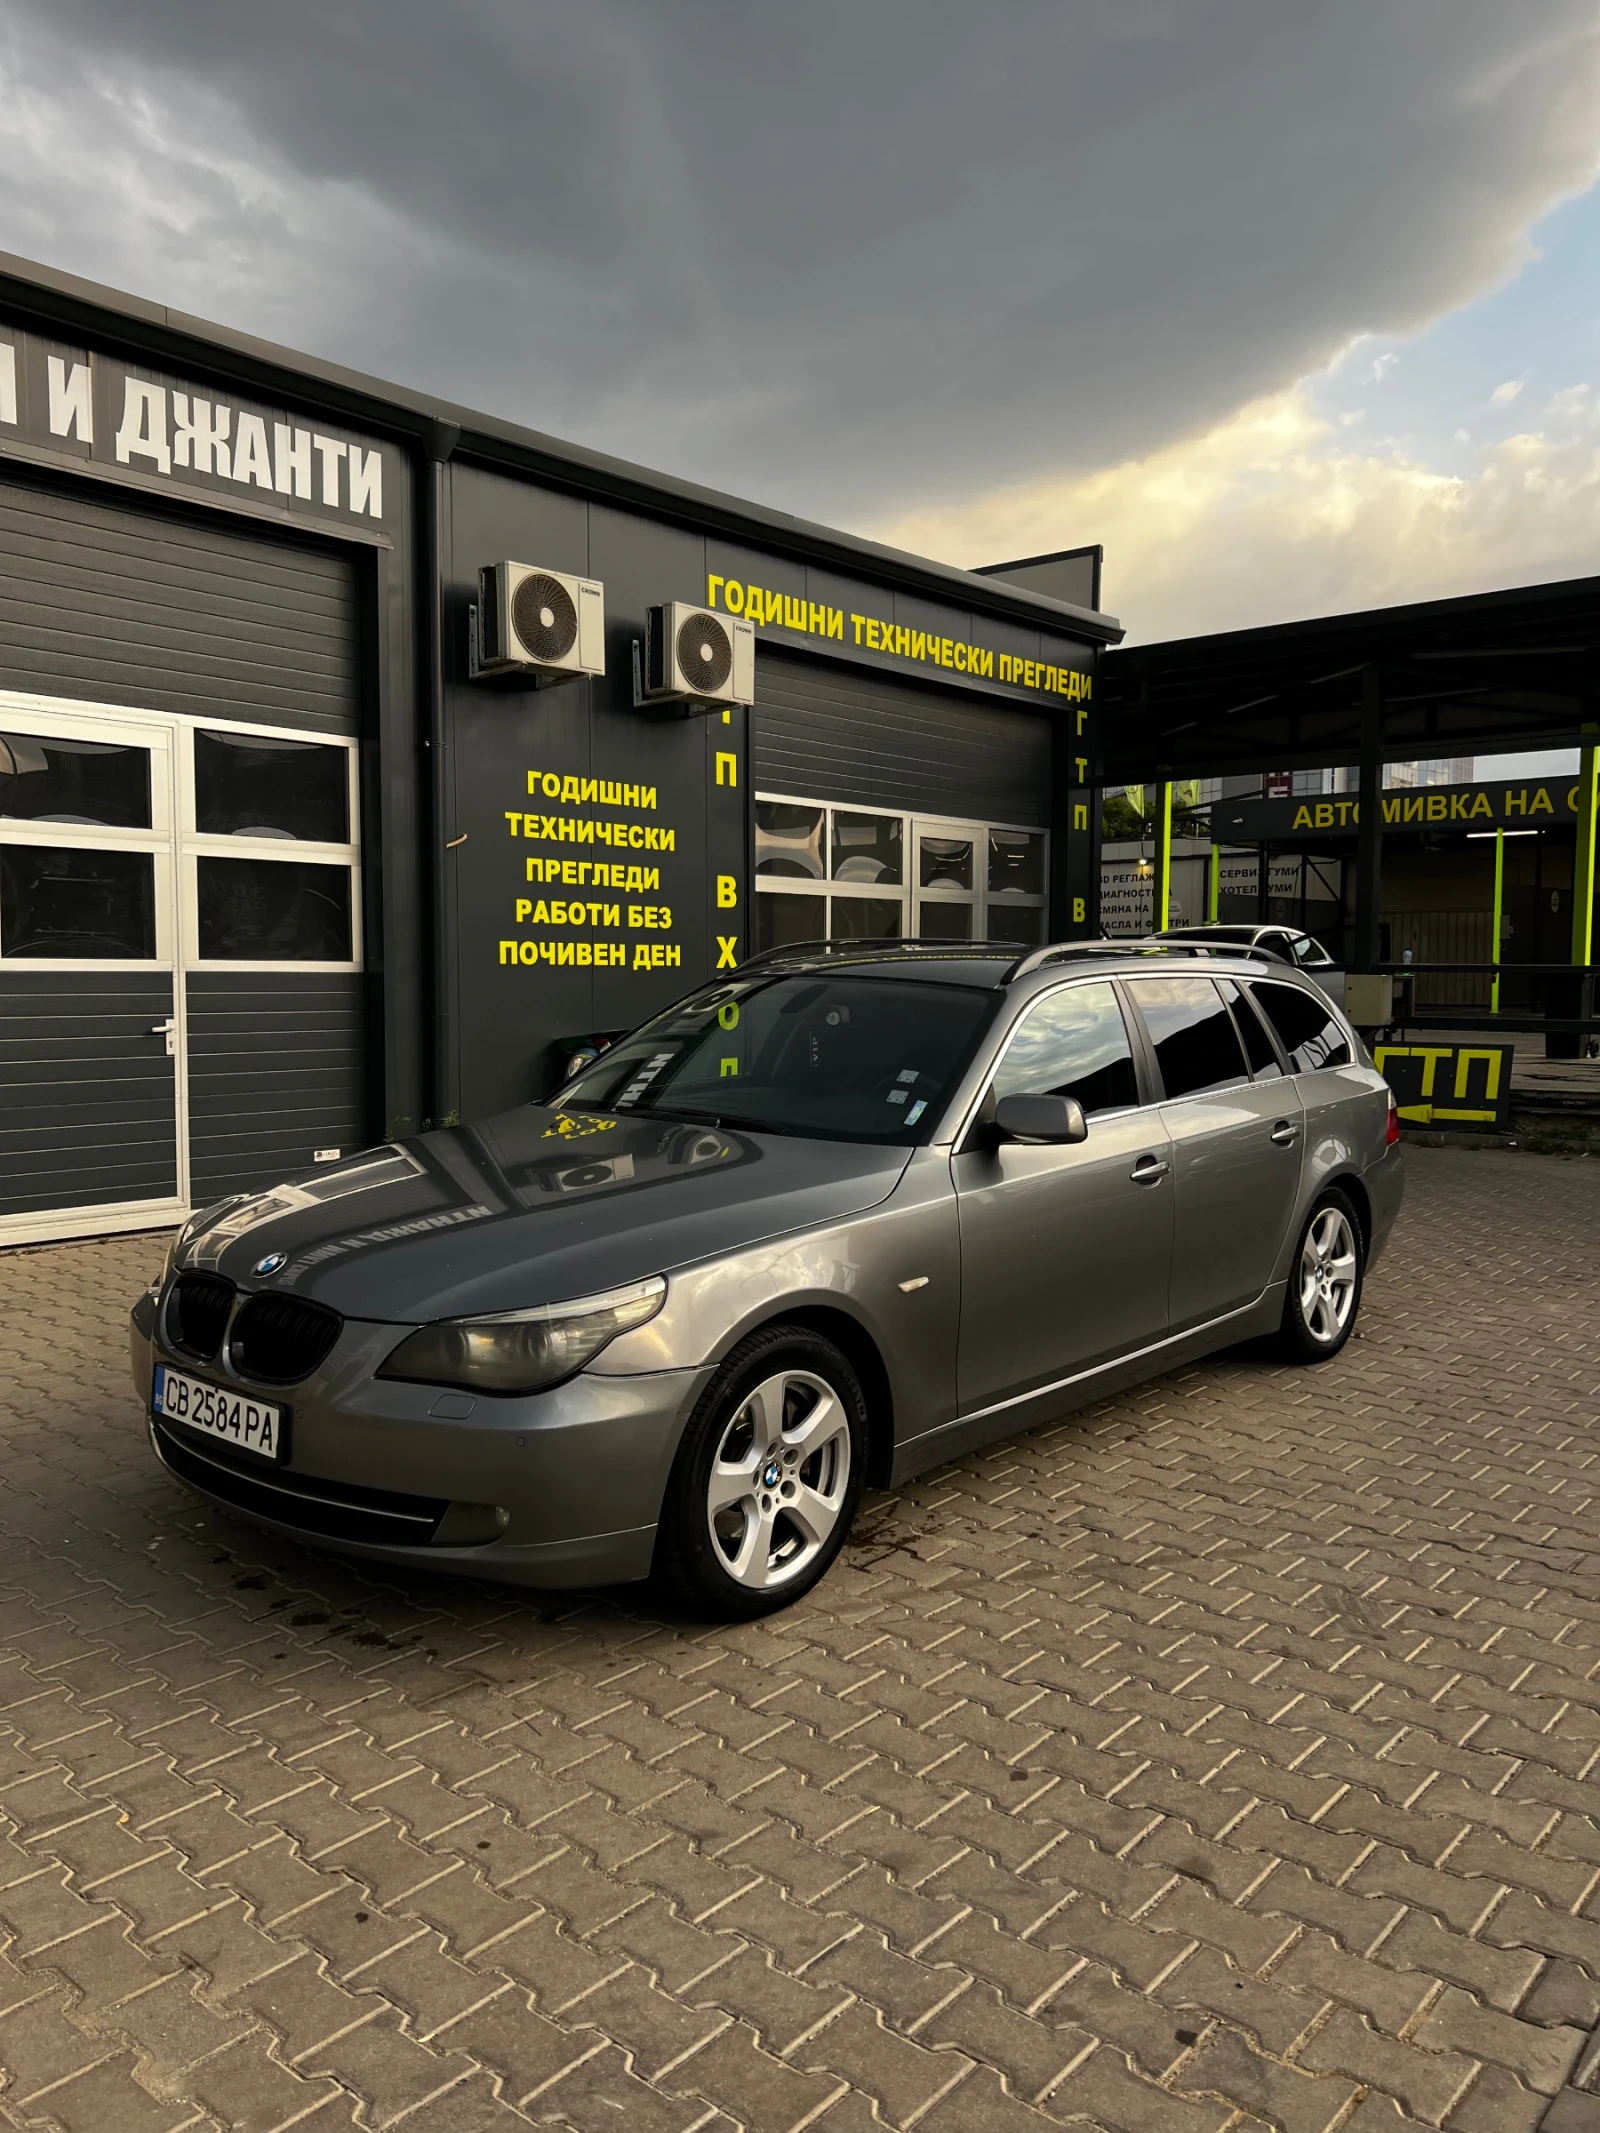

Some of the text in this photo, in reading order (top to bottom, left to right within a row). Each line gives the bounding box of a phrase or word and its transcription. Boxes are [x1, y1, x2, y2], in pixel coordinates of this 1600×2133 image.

[48, 355, 93, 444] И
[115, 376, 382, 519] ДЖАНТИ
[580, 586, 601, 598] CROWN
[708, 574, 1092, 703] ГОДИШНИ ТЕХНИЧЕСКИ ПРЕГЛЕДИ
[735, 625, 752, 635] CROWN
[527, 770, 657, 810] ГОДИШНИ
[1504, 787, 1555, 817] НА
[504, 811, 675, 852] ТЕХНИЧЕСКИ
[526, 857, 660, 894] ПРЕГЛЕДИ
[1219, 884, 1293, 894] ХОТЕЛ УМИ
[515, 899, 673, 930] РАБОТИ БЕЗ
[1134, 904, 1149, 913] НА
[499, 940, 681, 971] ПОЧИВЕН ДЕН
[1373, 1046, 1503, 1100] ГТП
